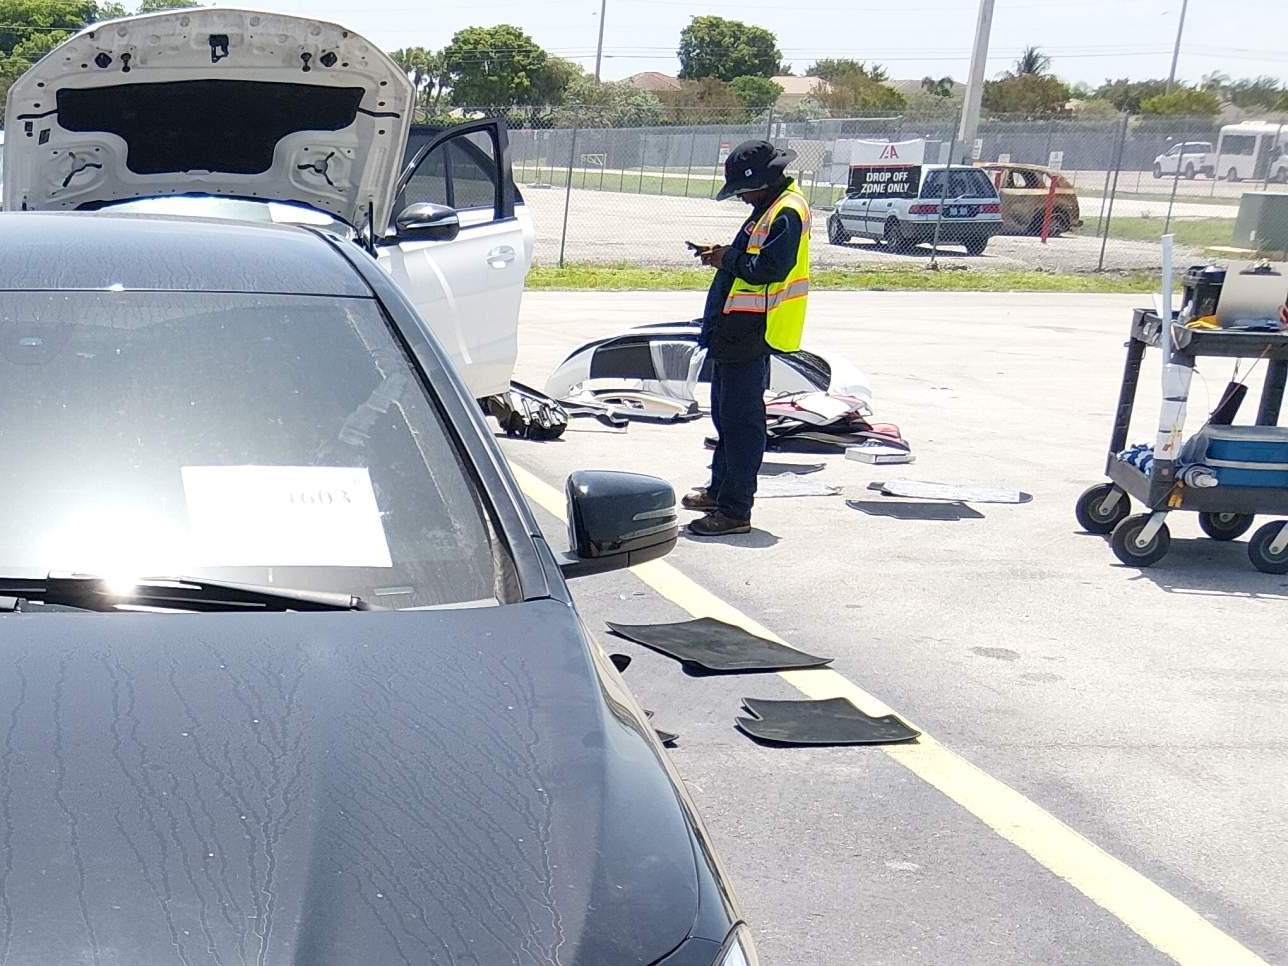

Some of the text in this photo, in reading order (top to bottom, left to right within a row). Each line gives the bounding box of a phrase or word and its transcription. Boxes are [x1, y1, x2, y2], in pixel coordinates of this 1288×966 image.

[866, 172, 908, 182] DROP OFF
[861, 182, 910, 193] ZONE ONLY
